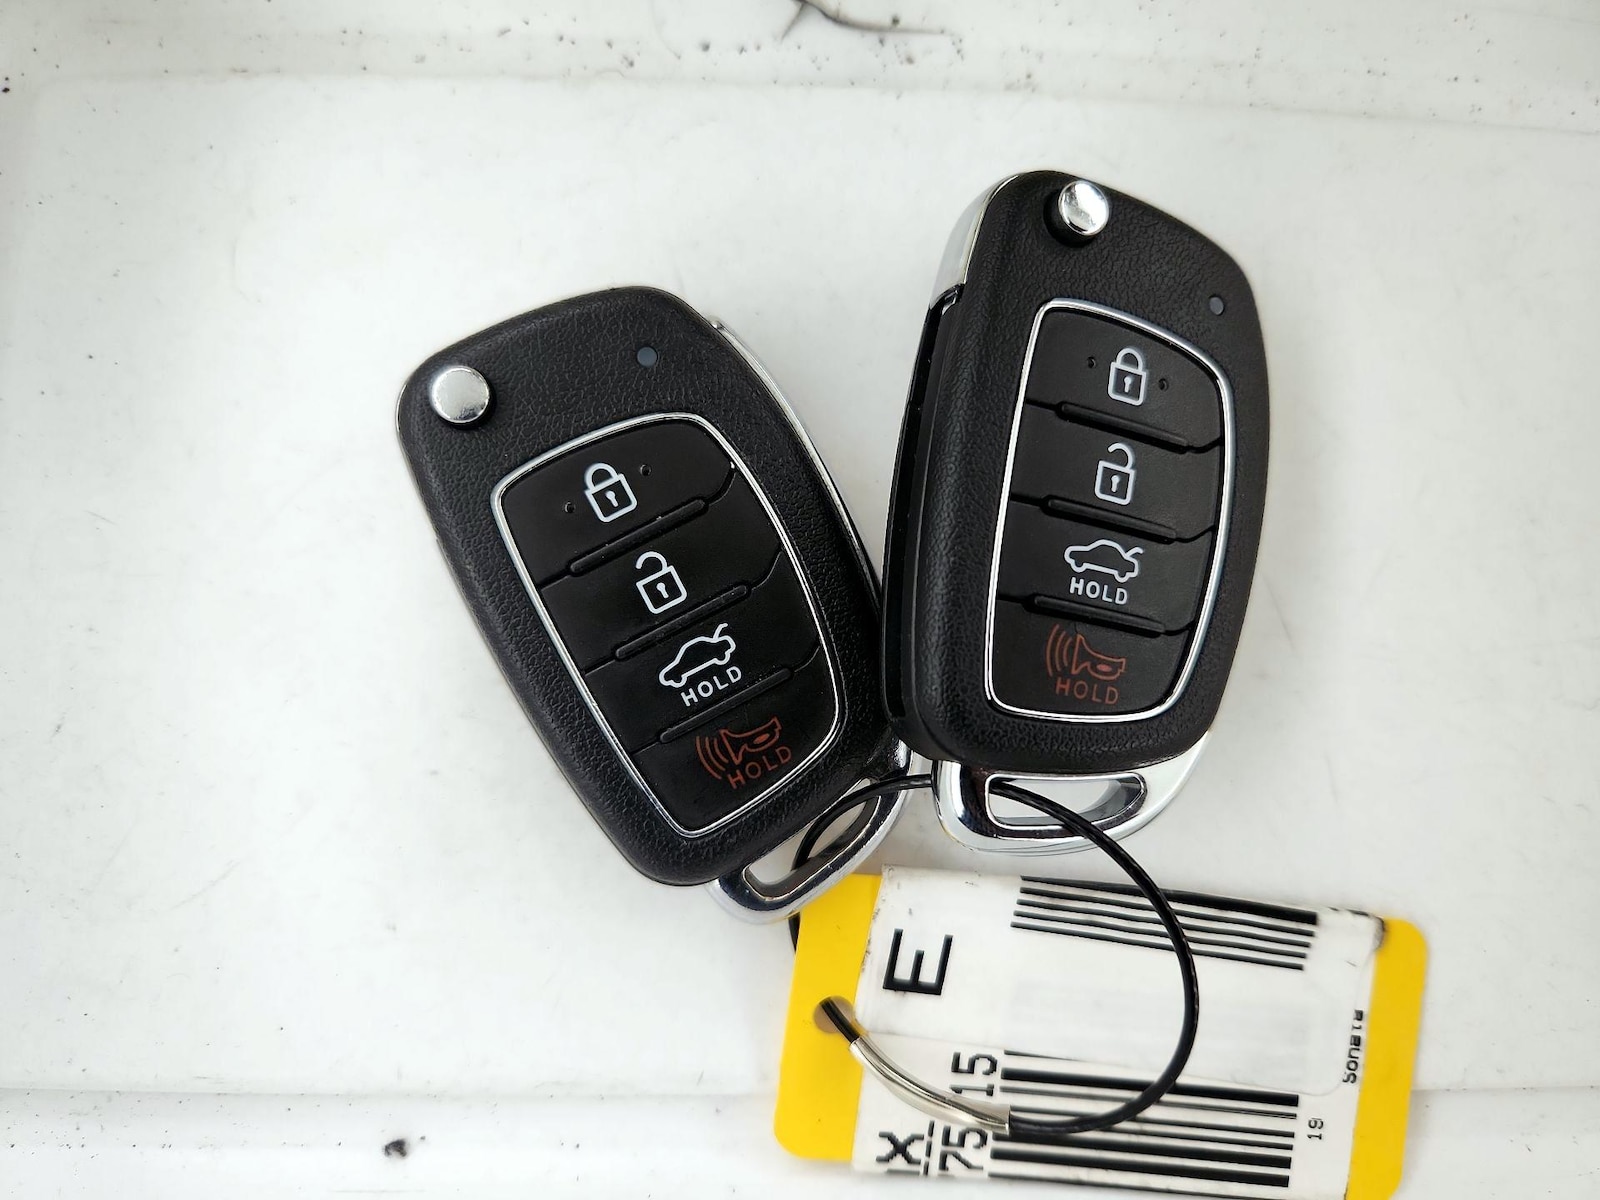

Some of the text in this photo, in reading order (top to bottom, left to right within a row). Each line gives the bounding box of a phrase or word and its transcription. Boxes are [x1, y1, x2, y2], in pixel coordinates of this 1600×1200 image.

[1069, 578, 1128, 605] HOLD
[681, 665, 743, 707] HOLD
[1055, 678, 1120, 705] HOLD
[726, 745, 792, 790] HOLD
[883, 928, 953, 996] E
